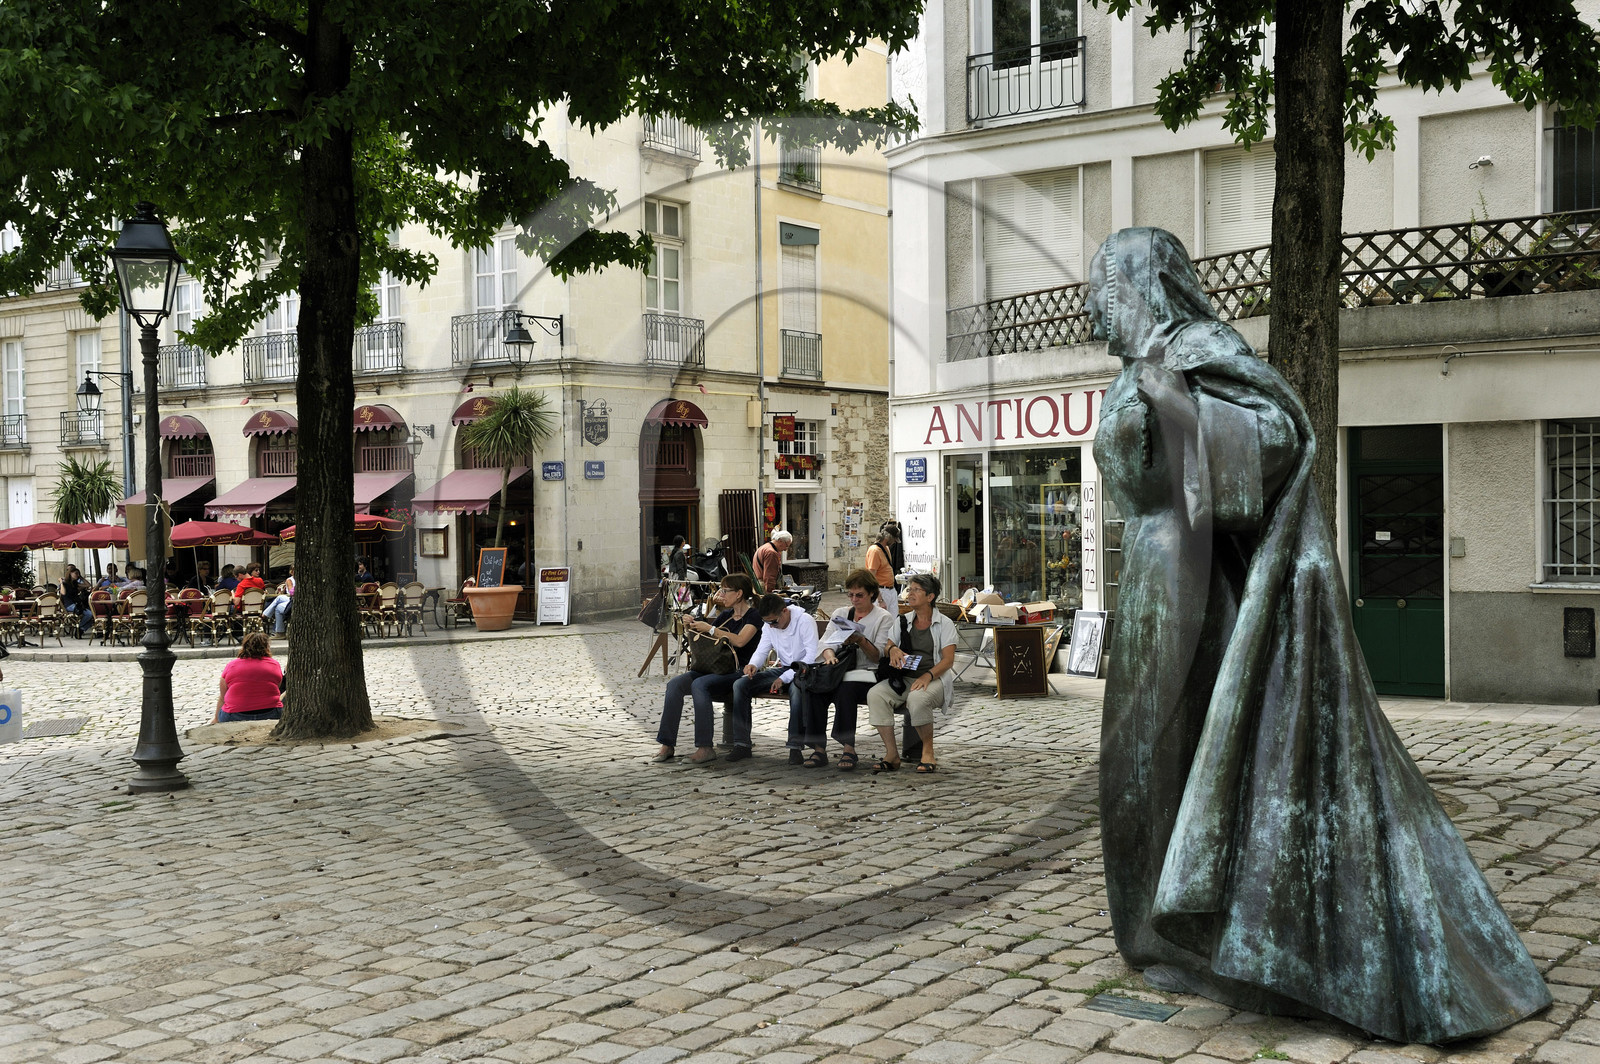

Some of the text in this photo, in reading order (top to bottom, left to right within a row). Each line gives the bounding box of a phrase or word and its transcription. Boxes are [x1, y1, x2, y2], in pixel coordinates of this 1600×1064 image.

[923, 389, 1106, 444] ANTIQU
[1084, 487, 1094, 502] 02
[907, 500, 927, 513] Achat
[1084, 508, 1095, 523] 40
[908, 525, 927, 538] Vente
[1084, 528, 1095, 543] 48
[903, 551, 935, 563] stimation
[1085, 548, 1095, 563] 77
[1085, 569, 1095, 584] 72
